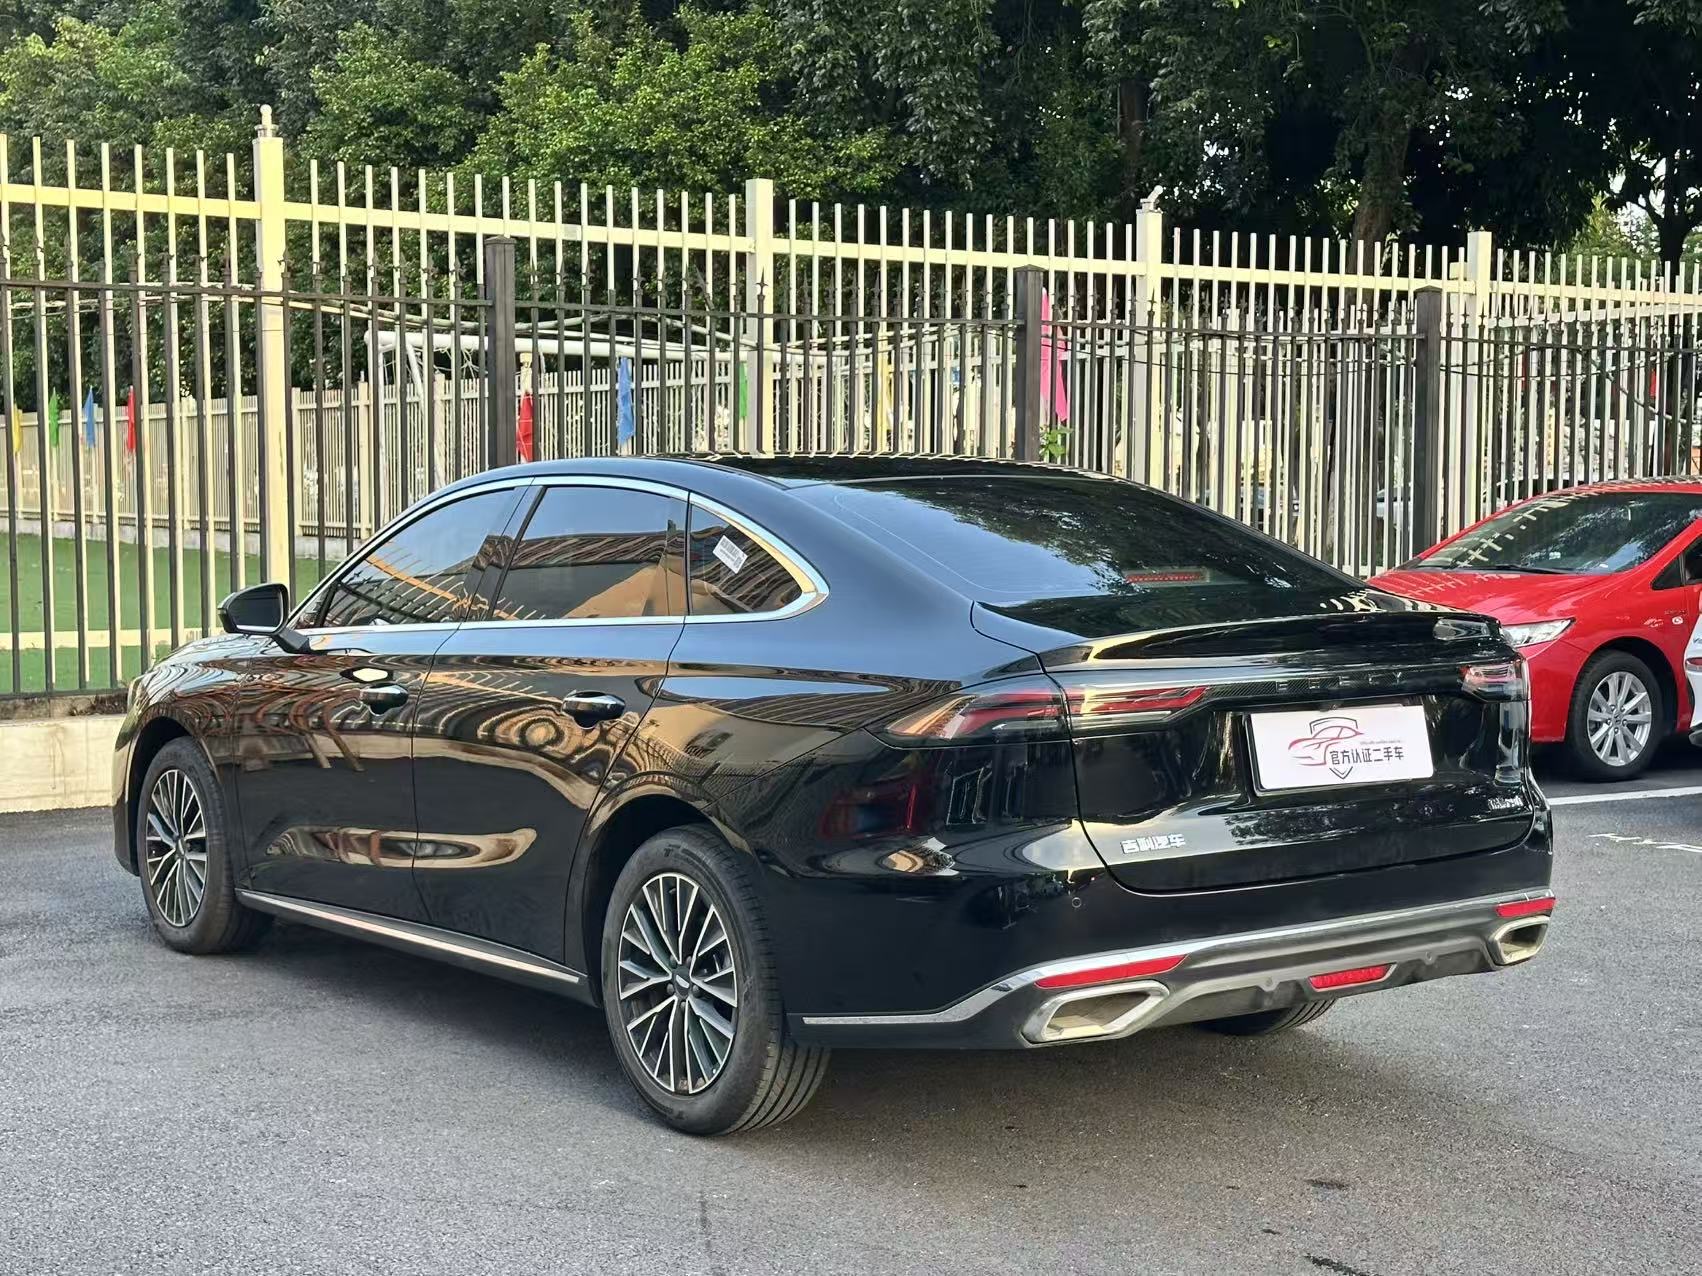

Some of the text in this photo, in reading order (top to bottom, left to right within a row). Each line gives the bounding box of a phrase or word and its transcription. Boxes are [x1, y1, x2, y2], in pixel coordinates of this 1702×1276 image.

[1329, 746, 1404, 765] 官方认证二手车
